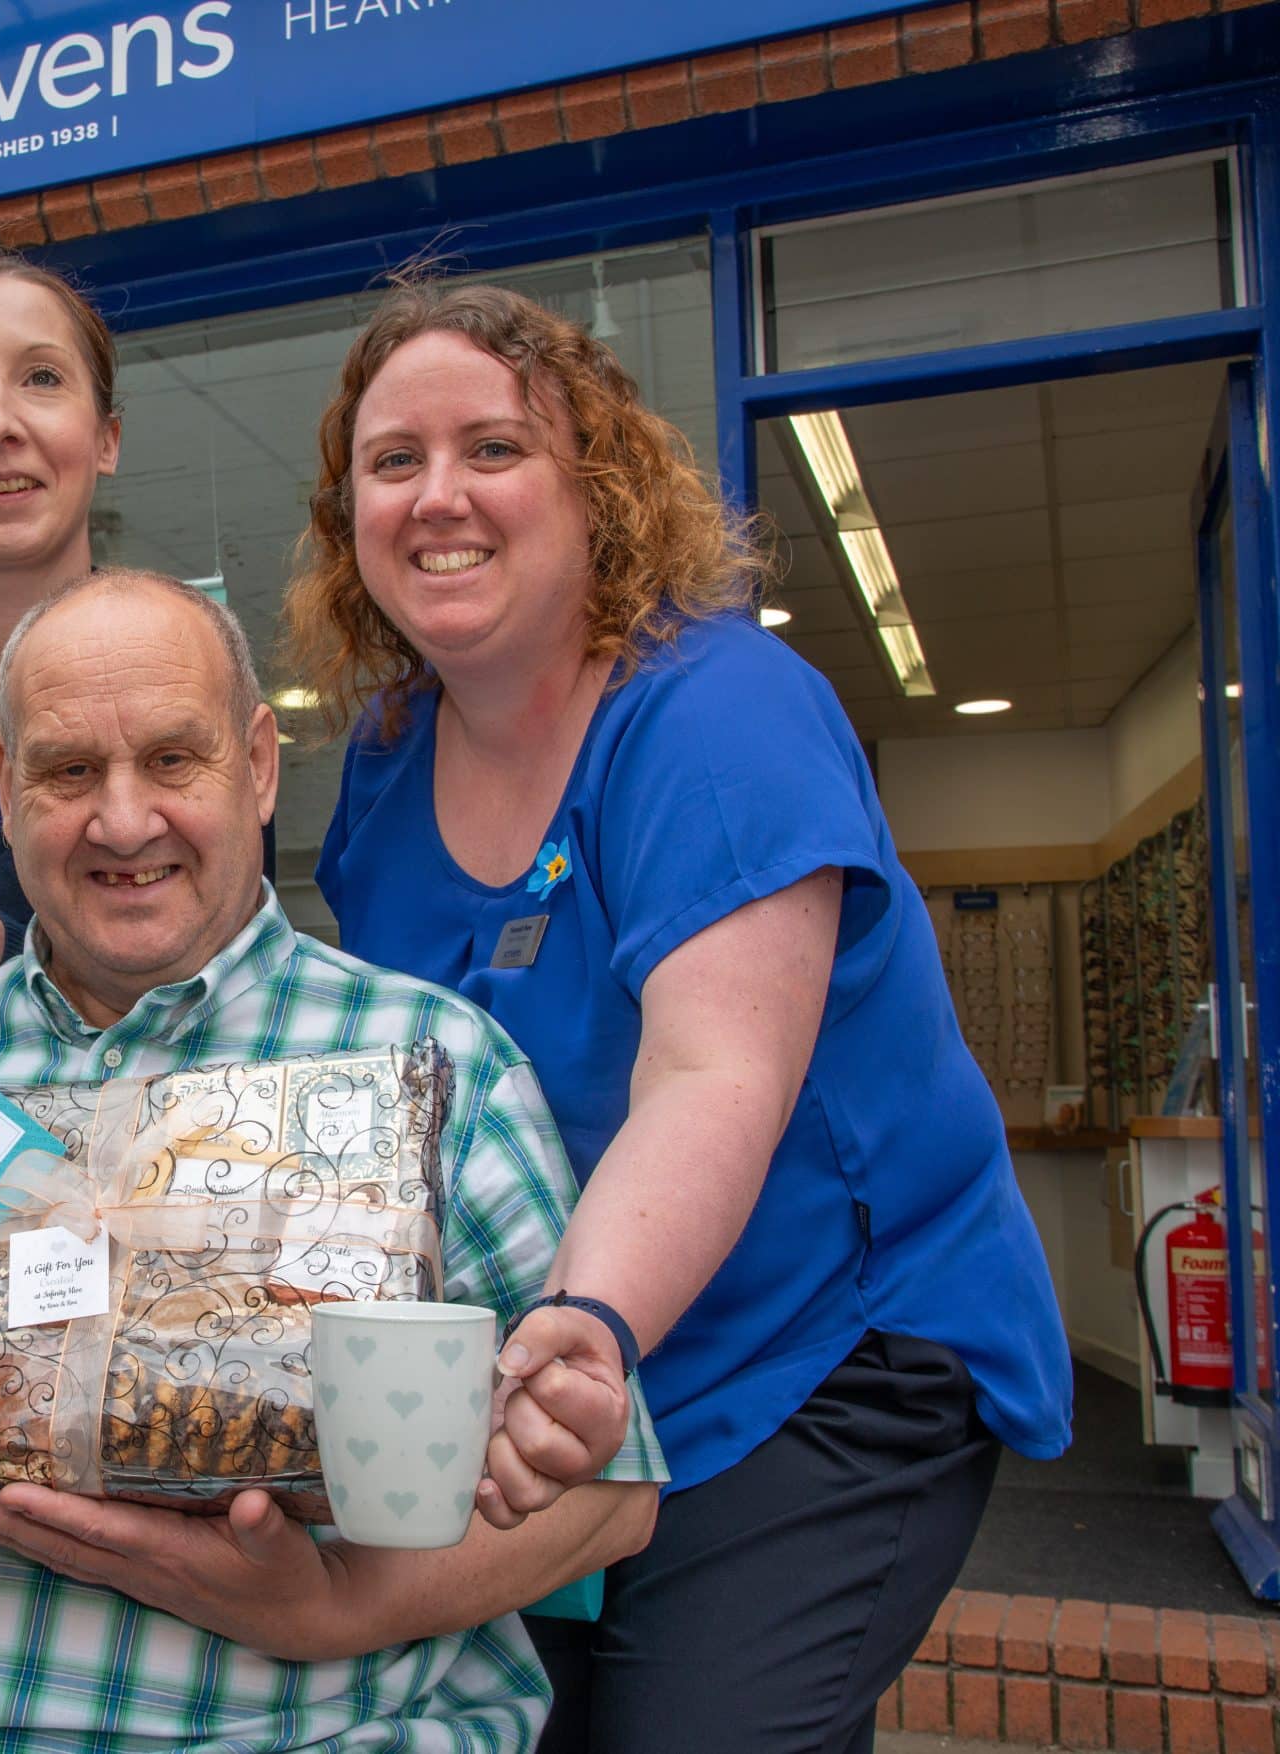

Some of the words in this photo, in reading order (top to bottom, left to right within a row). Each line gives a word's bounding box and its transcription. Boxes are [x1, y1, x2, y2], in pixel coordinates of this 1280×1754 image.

[51, 122, 99, 147] 1938
[24, 1265, 32, 1276] A
[34, 1262, 53, 1277] Gift
[55, 1260, 71, 1271] For
[74, 1256, 94, 1272] You
[1182, 1256, 1225, 1271] Foam
